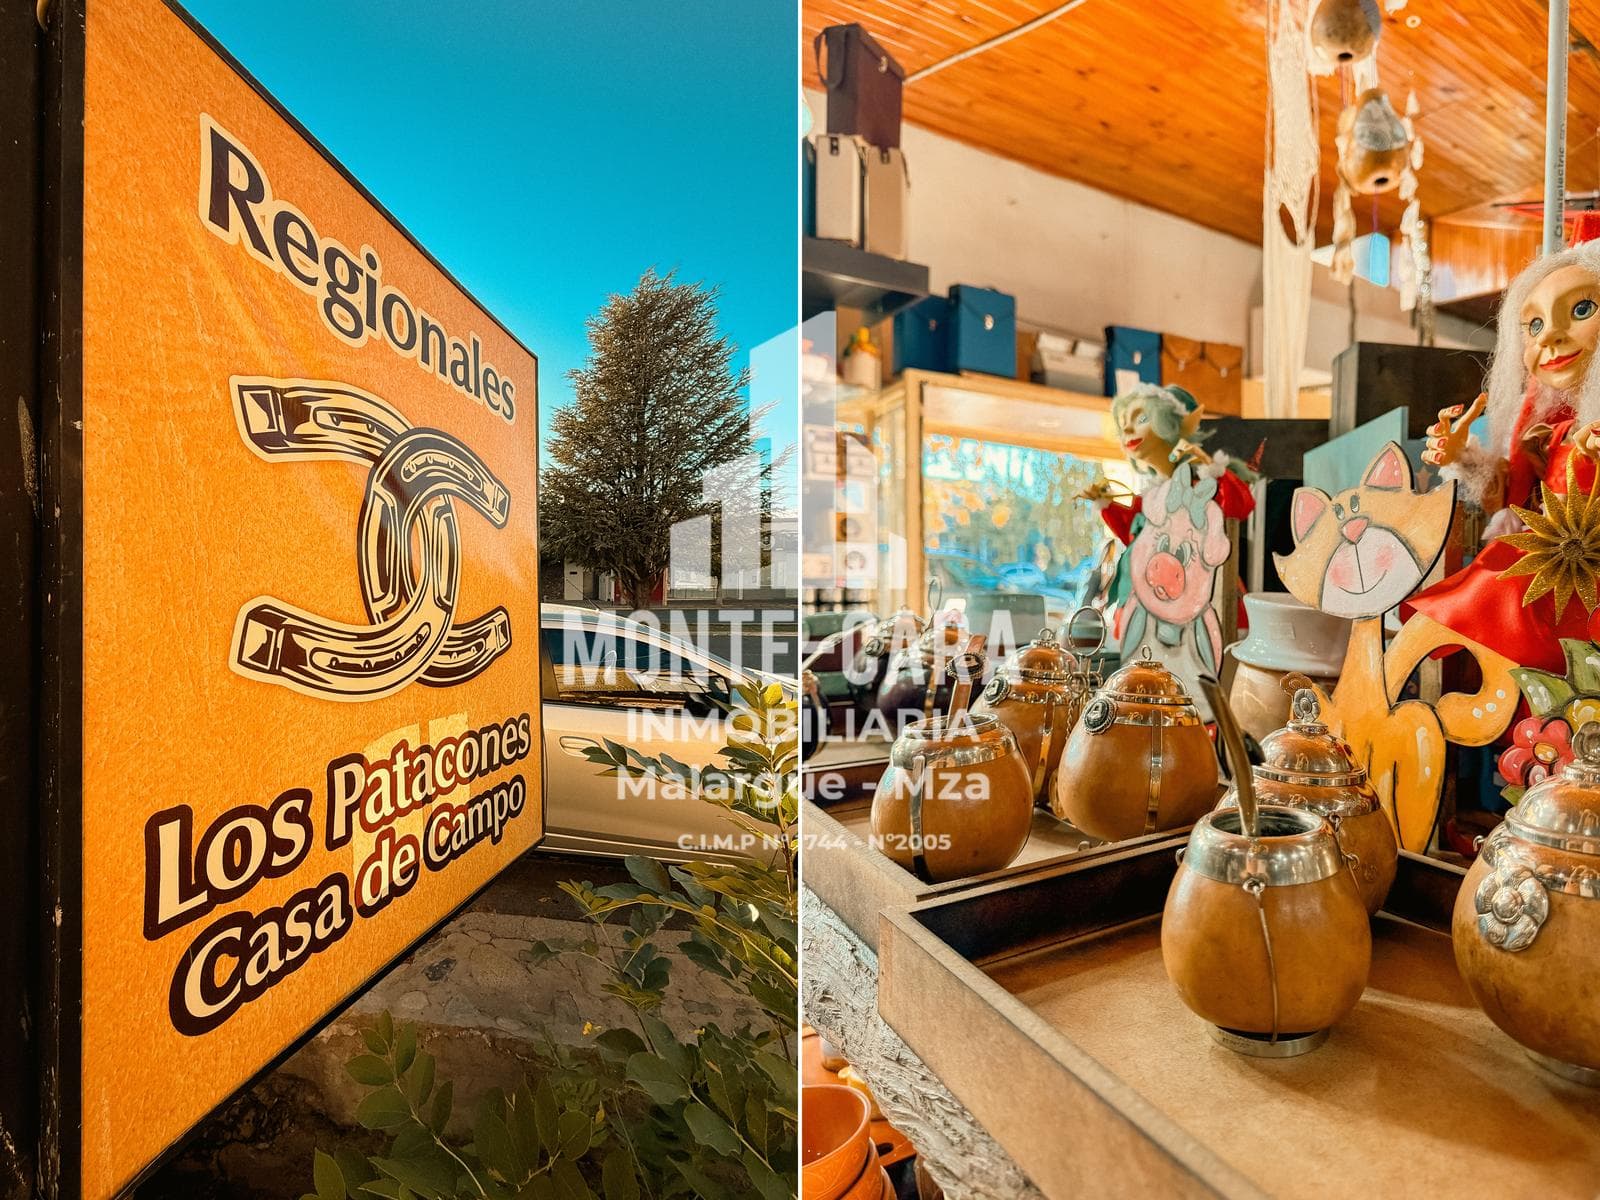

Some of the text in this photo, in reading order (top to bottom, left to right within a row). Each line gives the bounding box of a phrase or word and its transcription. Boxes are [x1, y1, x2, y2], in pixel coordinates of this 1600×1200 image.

[205, 119, 516, 422] Regionales
[149, 715, 530, 933] Los Patacones
[177, 778, 526, 1028] Casa de Campo
